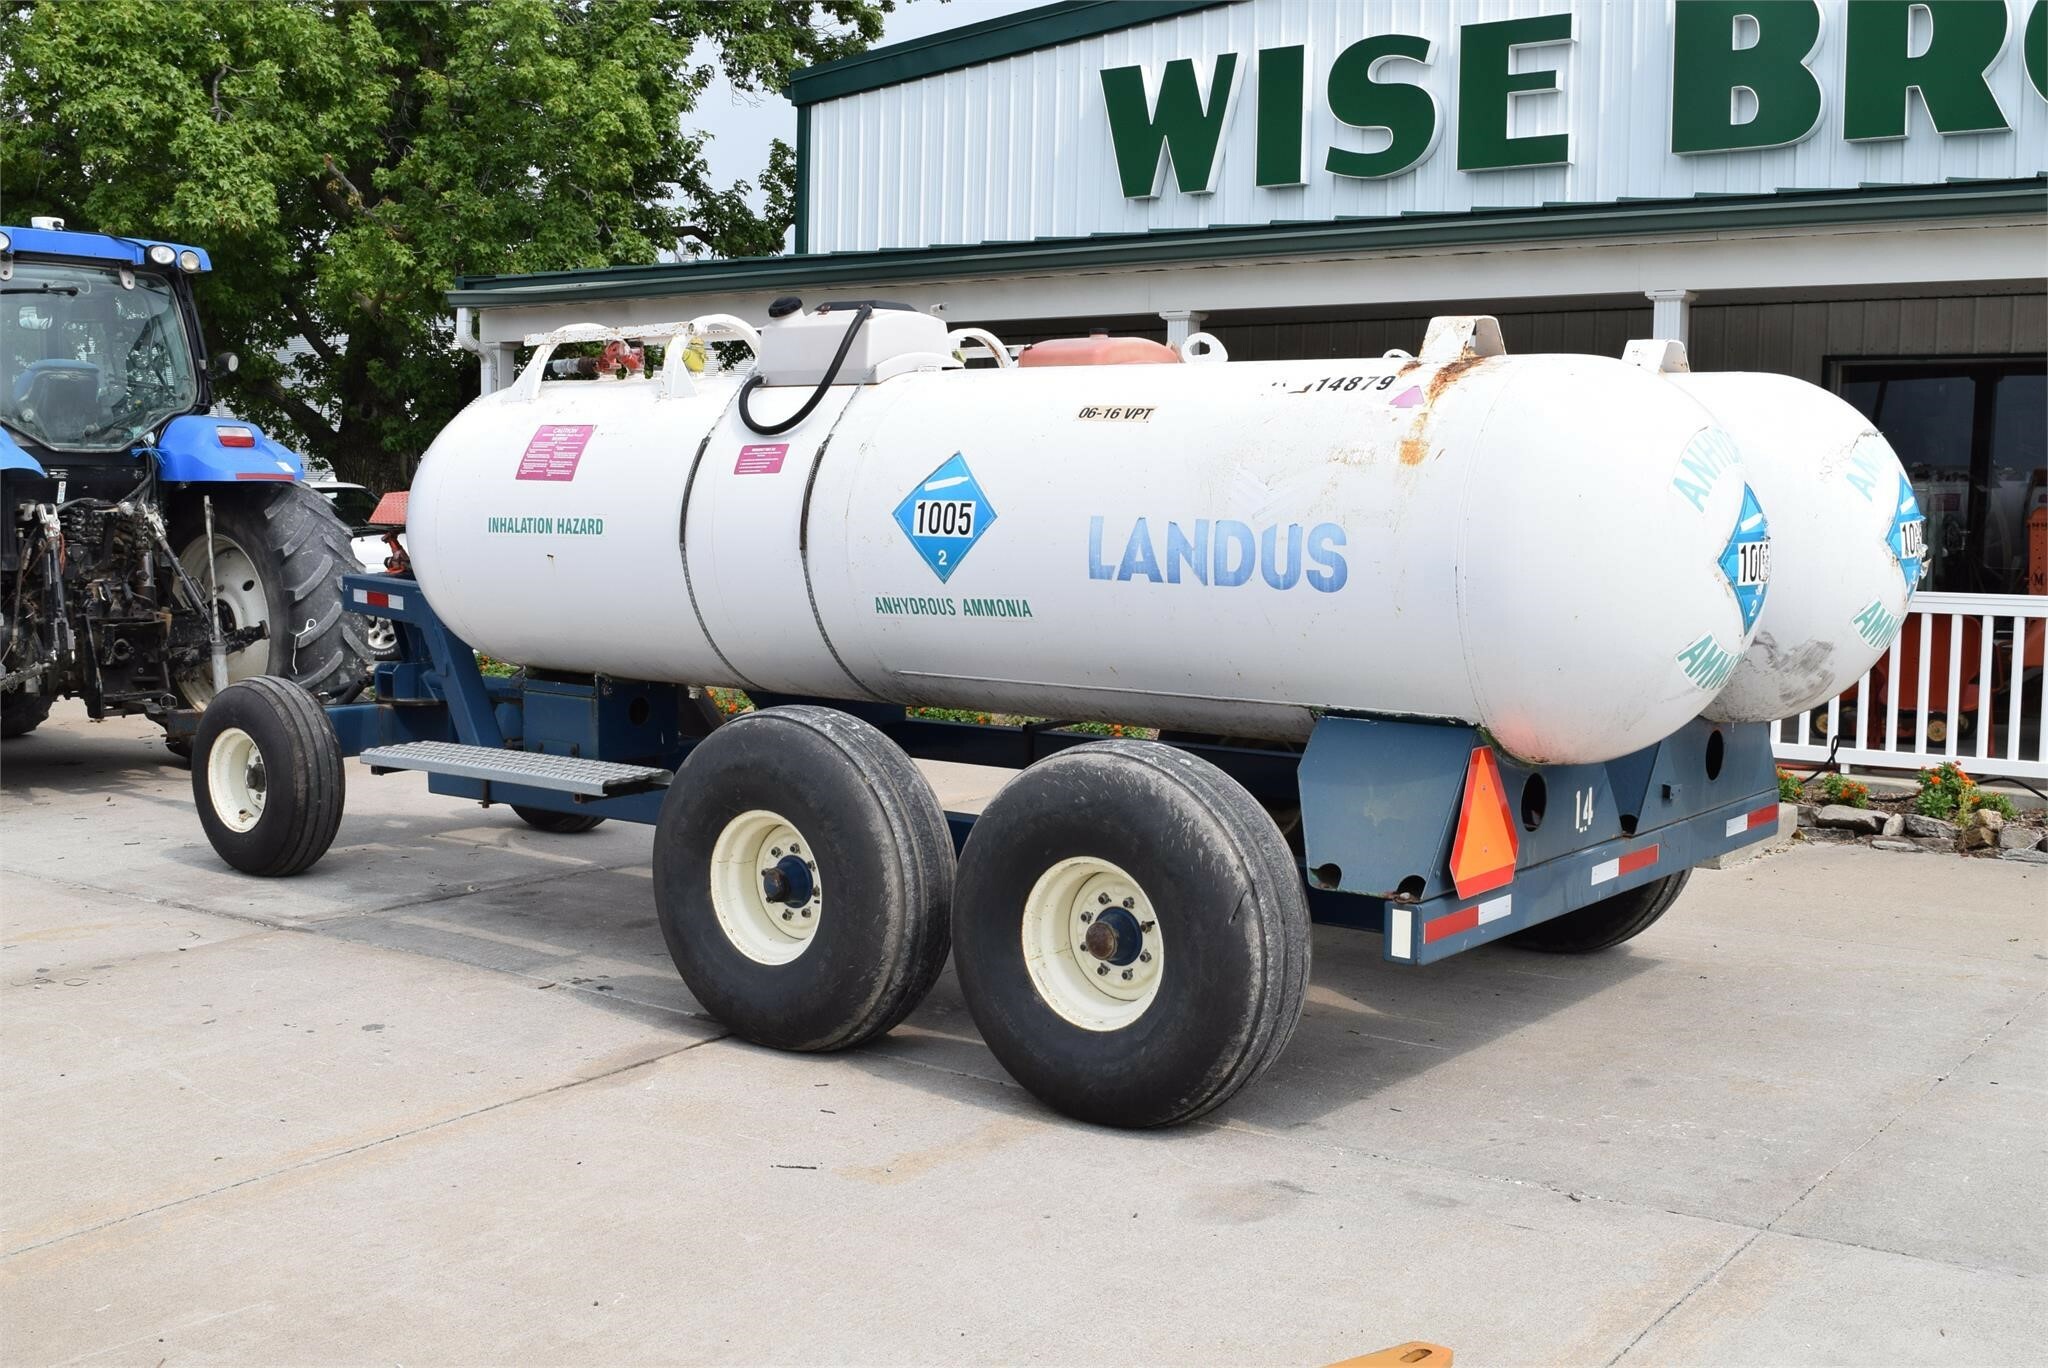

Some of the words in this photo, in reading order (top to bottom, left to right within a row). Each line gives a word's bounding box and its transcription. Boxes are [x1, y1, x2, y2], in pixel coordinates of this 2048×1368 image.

[1100, 14, 1577, 199] WISE
[1671, 0, 2048, 157] BR
[1078, 407, 1122, 419] 06-16
[1124, 408, 1155, 419] VPT
[488, 517, 553, 534] INHALATION
[556, 518, 604, 536] HAZARD
[917, 501, 973, 535] 1005
[937, 550, 948, 565] 2
[1088, 516, 1348, 593] LANDUS
[875, 597, 956, 616] ANHYDROUS
[962, 598, 1033, 618] AMMONIA
[1749, 599, 1758, 617] 2
[1575, 786, 1594, 830] 14
